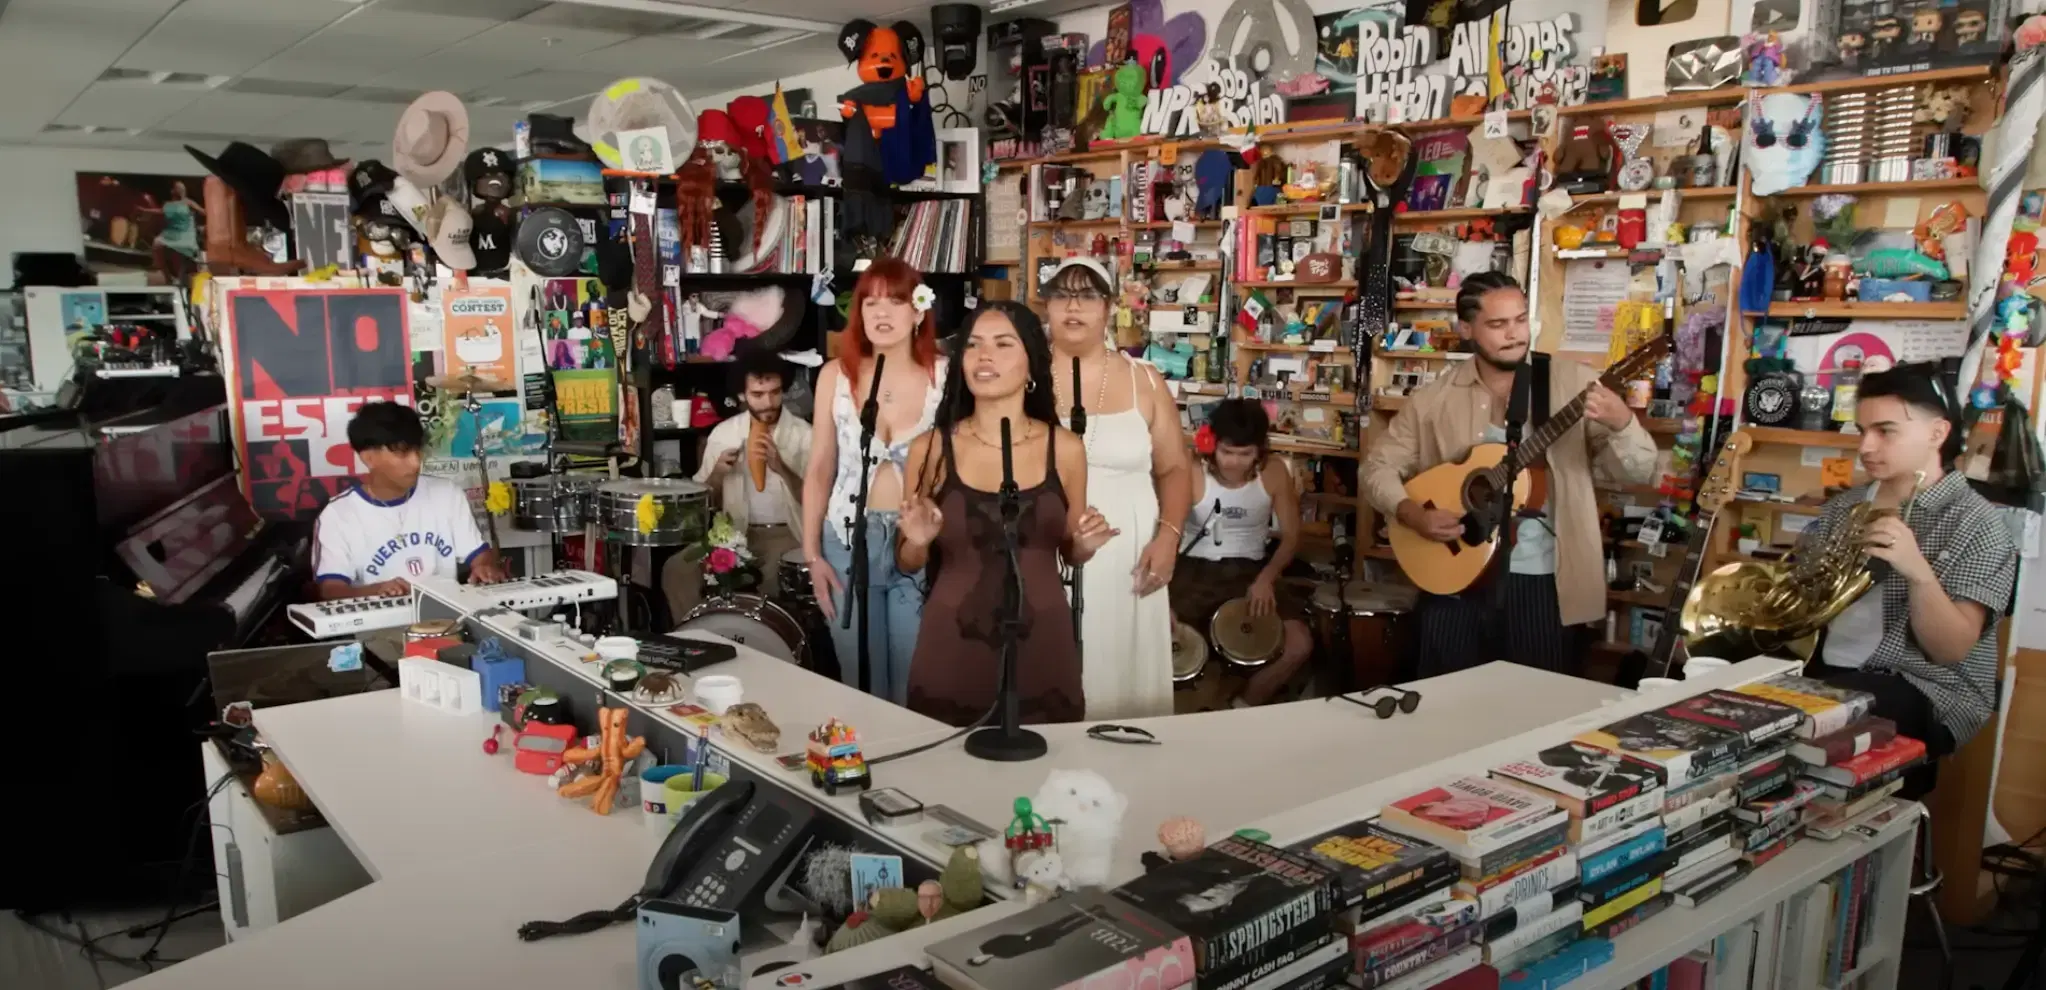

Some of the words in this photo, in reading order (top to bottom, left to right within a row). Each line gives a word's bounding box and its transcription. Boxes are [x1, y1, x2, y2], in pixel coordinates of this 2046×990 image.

[1358, 18, 1430, 76] Robin
[1450, 15, 1490, 77] All
[1207, 55, 1248, 99] Bob
[1355, 71, 1446, 121] Hilton
[1140, 82, 1208, 136] NPR
[1219, 81, 1286, 128] Boilen
[452, 302, 505, 313] CONTEST
[233, 293, 406, 398] NO
[243, 394, 410, 443] ESE
[366, 532, 420, 576] PUERTO
[425, 531, 453, 558] RICO
[1448, 780, 1494, 797] BOWIE
[1490, 793, 1532, 810] DAVID
[1514, 866, 1550, 901] PRINCE
[1589, 857, 1619, 878] DYLAN
[1228, 889, 1317, 961] SPRINGSTEEN
[1216, 971, 1251, 990] HNNY
[1251, 962, 1276, 980] CASH
[1276, 951, 1295, 967] FAQ
[1384, 950, 1429, 980] COUNTRY
